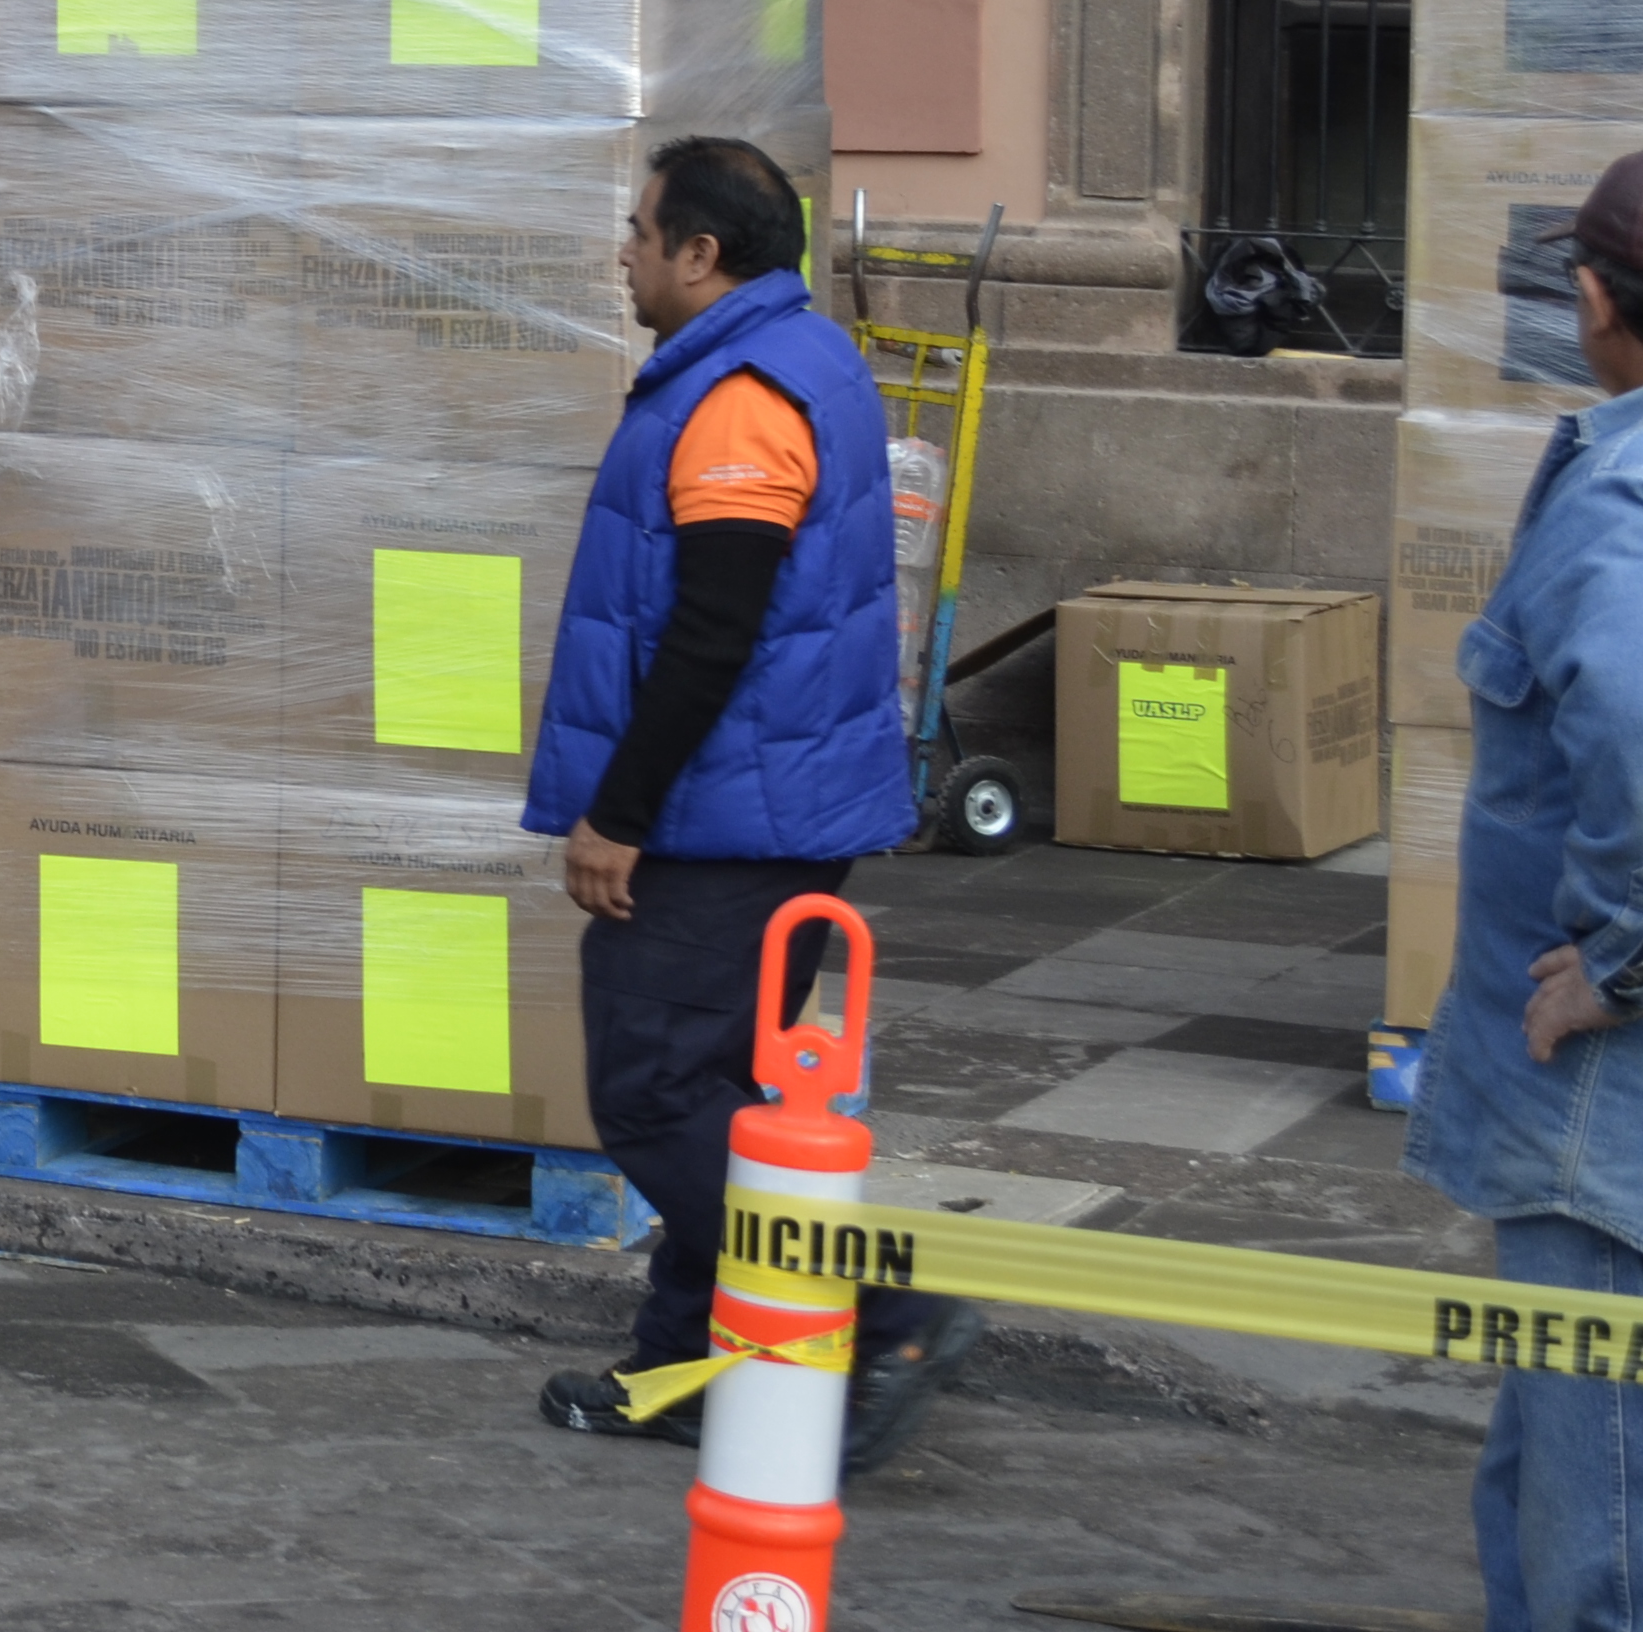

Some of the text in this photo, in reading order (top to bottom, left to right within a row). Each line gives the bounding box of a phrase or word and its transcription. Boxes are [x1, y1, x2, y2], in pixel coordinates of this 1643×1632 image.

[1484, 170, 1603, 186] AYUDA HUMAN
[416, 316, 444, 349] NO
[363, 515, 539, 537] AYUDA HUMANITARIA
[1399, 542, 1473, 580] FUERZA
[1412, 591, 1447, 611] SIGAN
[74, 626, 100, 659] NO
[168, 633, 227, 666] SOLOS
[1132, 699, 1206, 722] UASLP
[29, 818, 81, 835] AYUDA
[407, 855, 525, 878] HUMANITARIA
[721, 1206, 913, 1287] UCION
